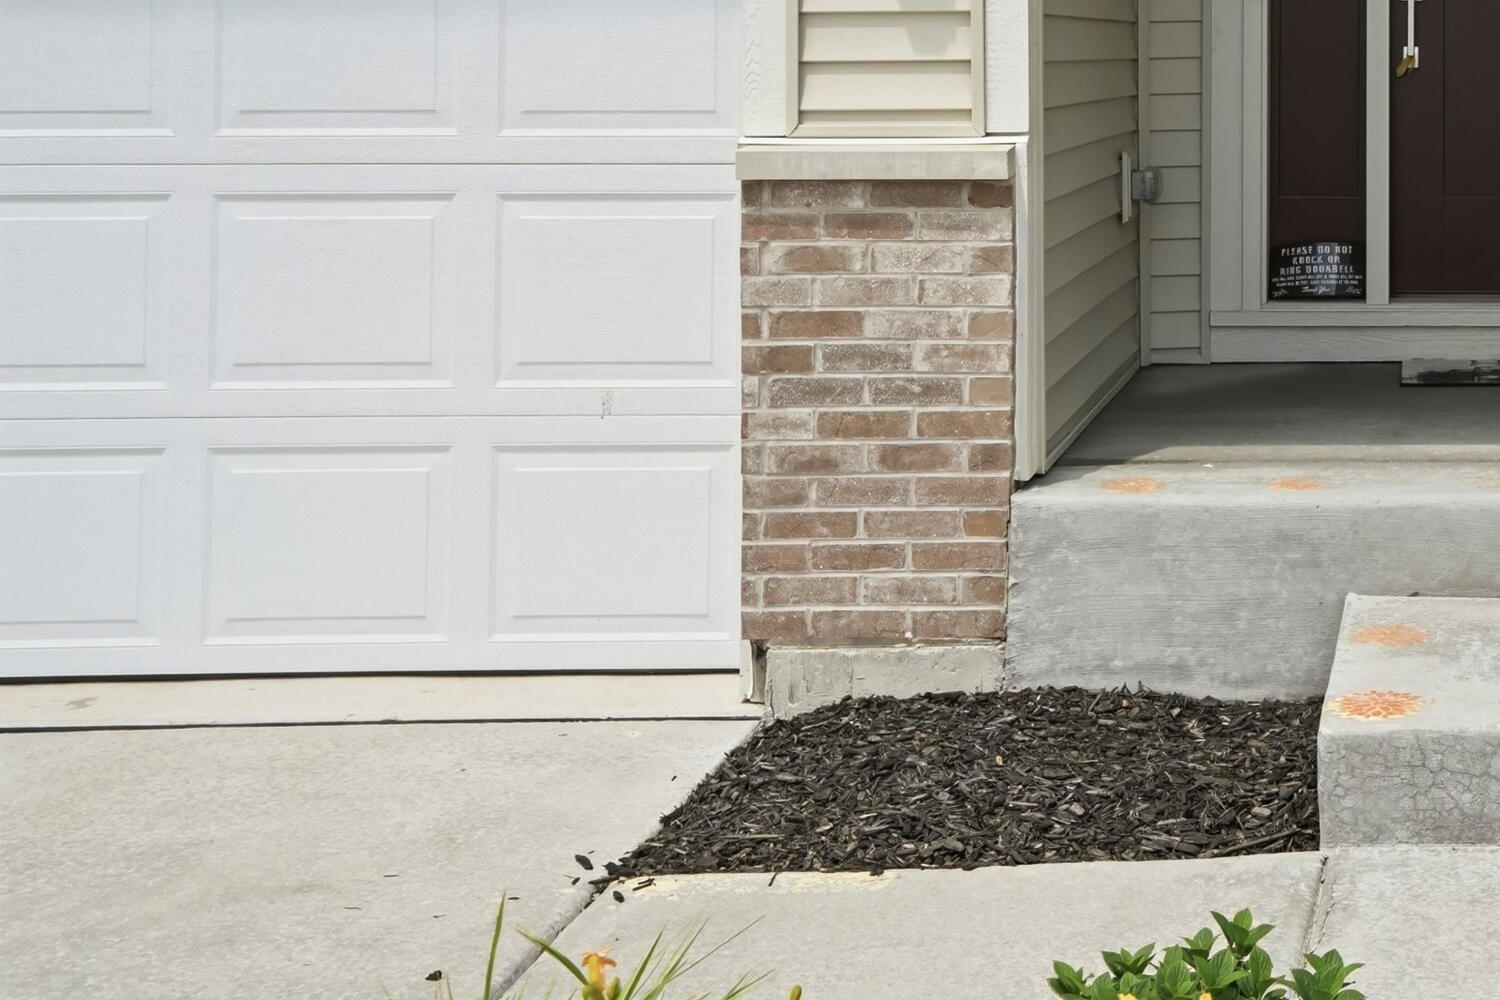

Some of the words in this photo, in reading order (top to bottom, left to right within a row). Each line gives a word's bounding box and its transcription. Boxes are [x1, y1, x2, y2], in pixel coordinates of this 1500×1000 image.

[1281, 246, 1313, 256] PLEASE
[1317, 245, 1330, 254] DO
[1335, 245, 1352, 254] NOT
[1292, 256, 1323, 265] KNOCK
[1327, 255, 1341, 264] OR
[1280, 266, 1301, 275] RING
[1305, 265, 1354, 274] DOORBELL
